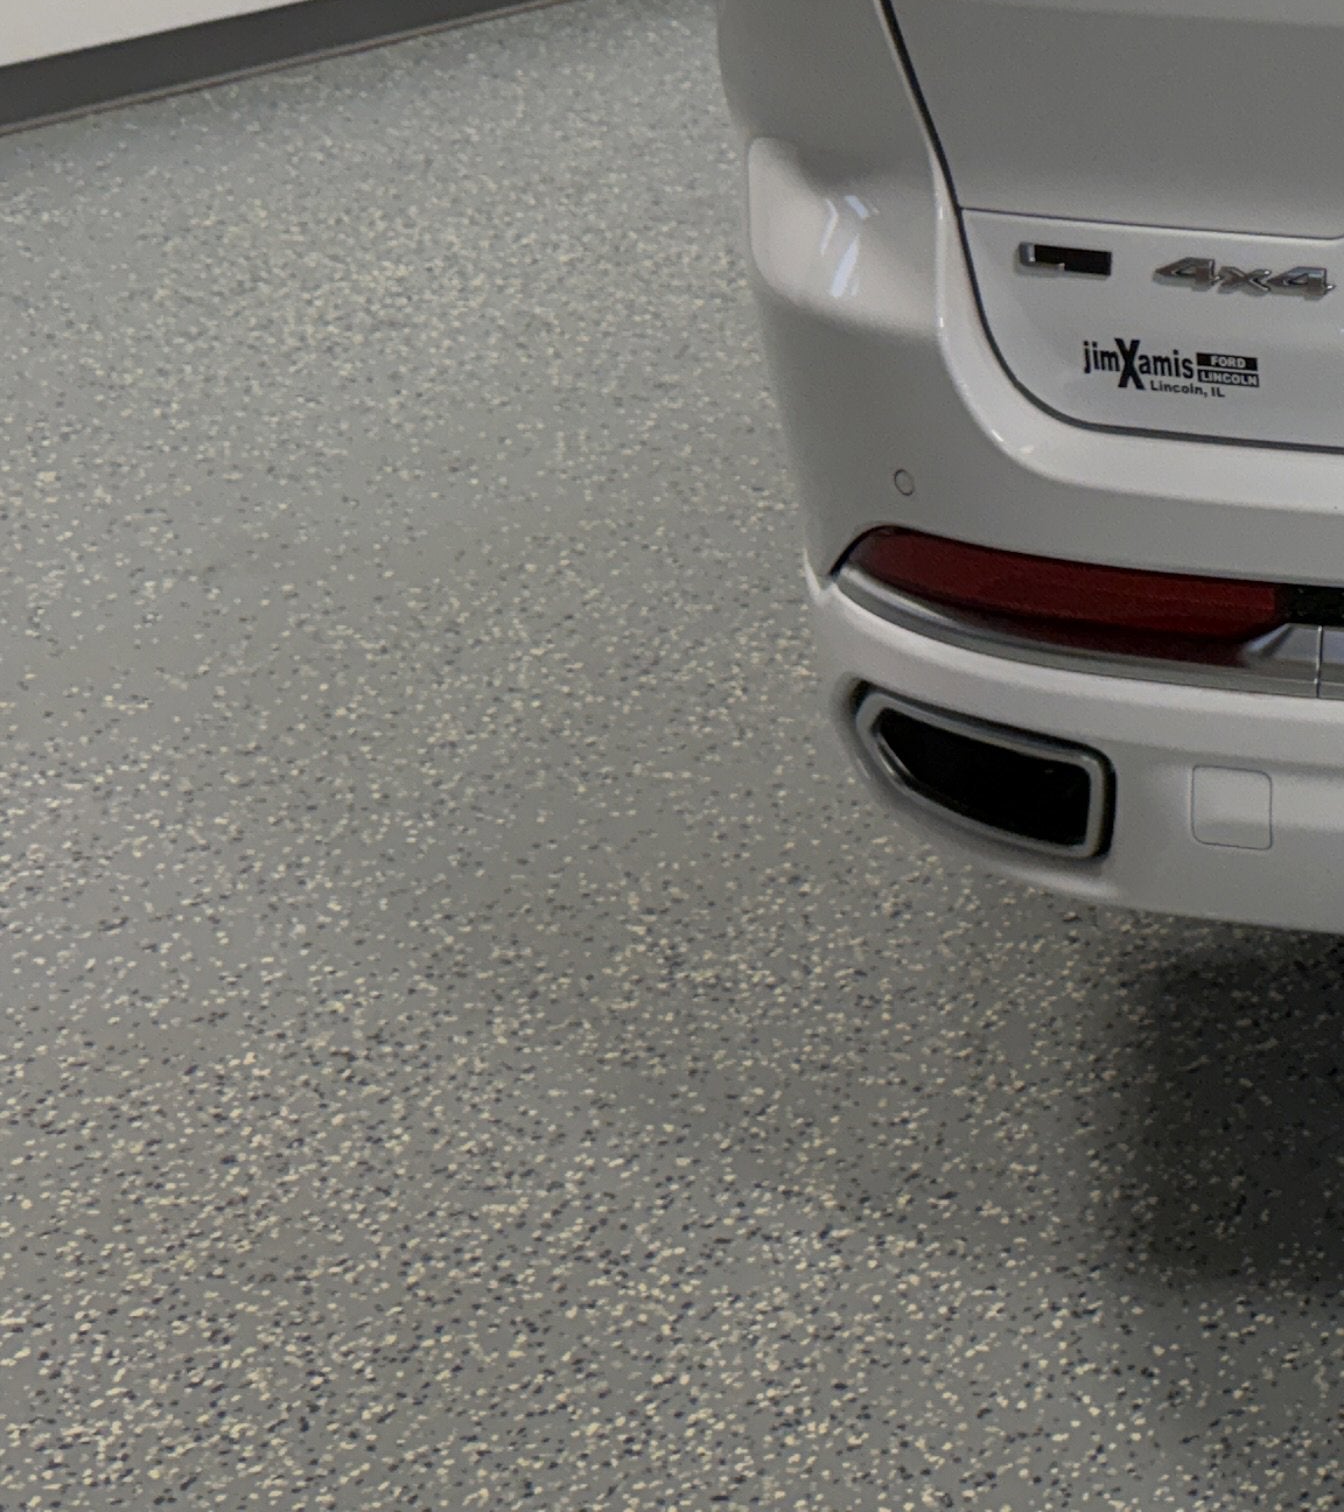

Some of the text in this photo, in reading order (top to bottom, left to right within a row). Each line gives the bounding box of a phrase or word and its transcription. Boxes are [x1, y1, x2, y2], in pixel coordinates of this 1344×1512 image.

[1083, 337, 1195, 390] jimXamis
[1210, 355, 1247, 369] FORD
[1201, 371, 1257, 386] LINCOLN
[1150, 380, 1226, 398] Lincoln, IL
